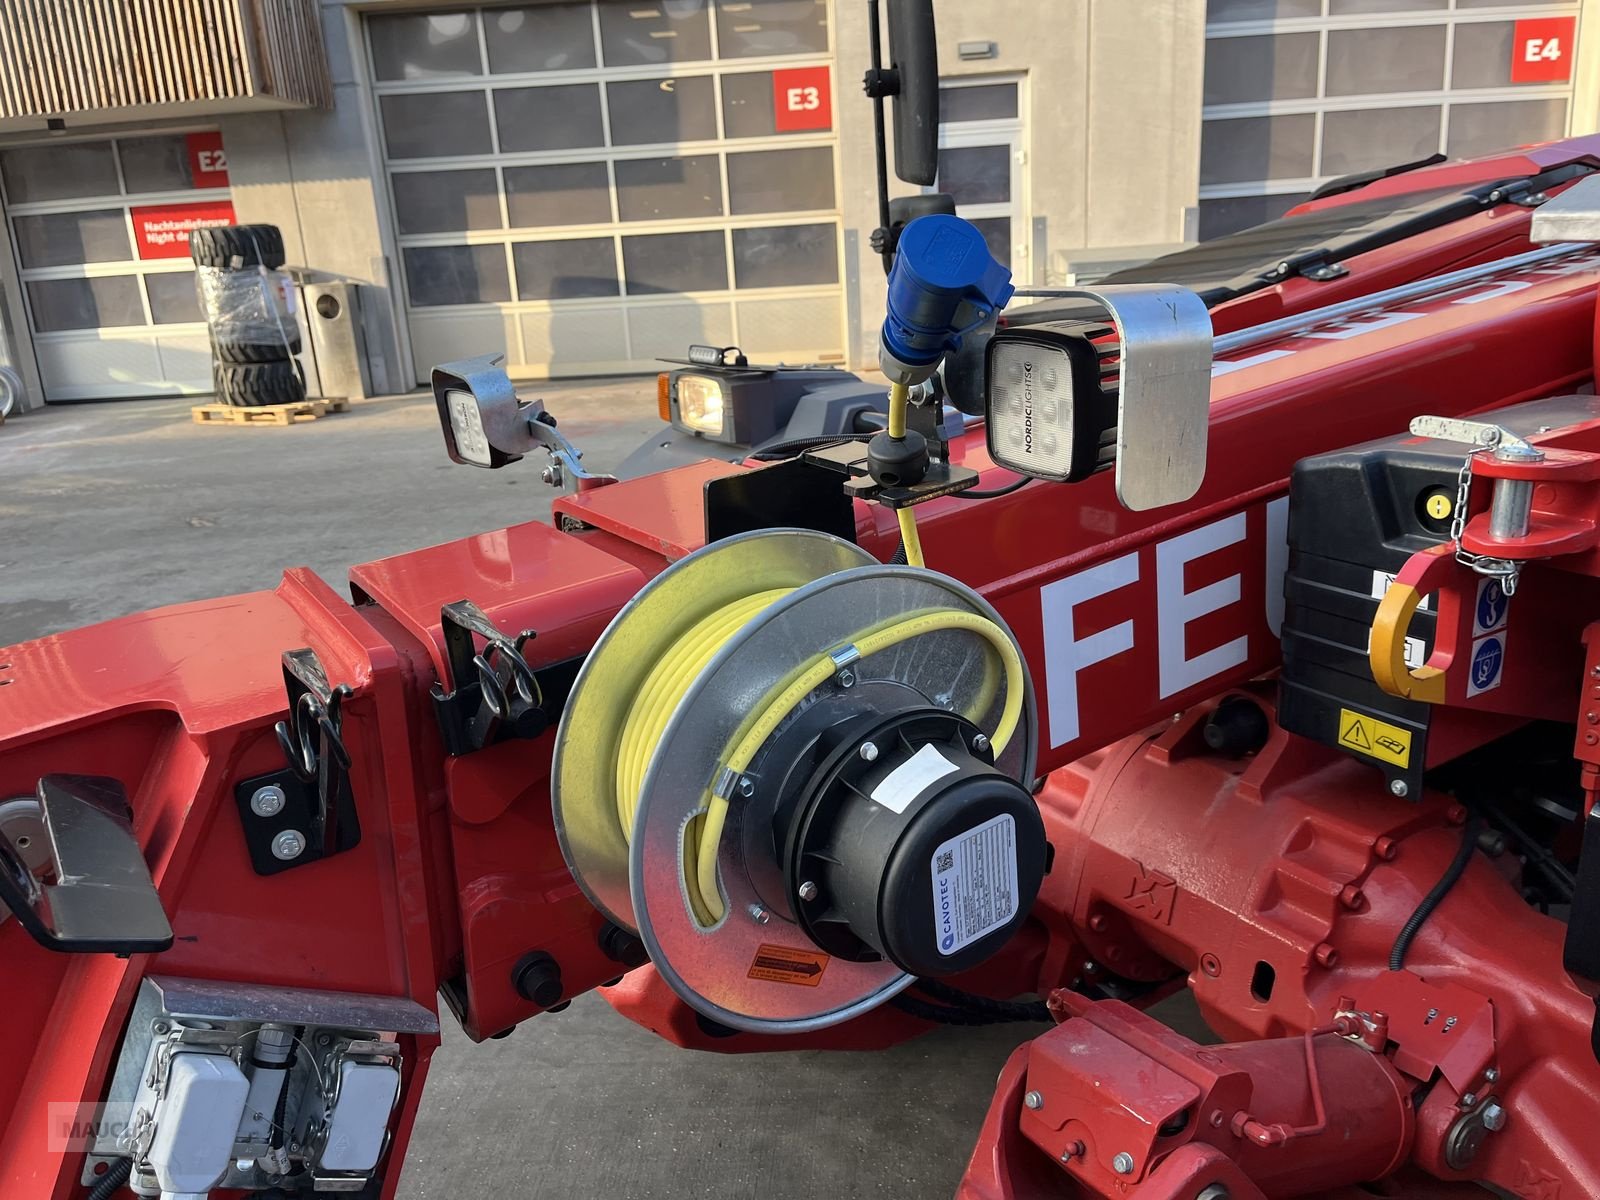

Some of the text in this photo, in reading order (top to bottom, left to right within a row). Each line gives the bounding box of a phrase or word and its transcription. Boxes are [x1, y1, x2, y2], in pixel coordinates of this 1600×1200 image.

[1524, 38, 1561, 63] E4
[787, 86, 820, 111] E3
[198, 150, 228, 172] E2
[146, 231, 175, 245] Night
[1023, 373, 1033, 454] NORDICLIGHTS
[940, 878, 952, 933] CAVOTEC
